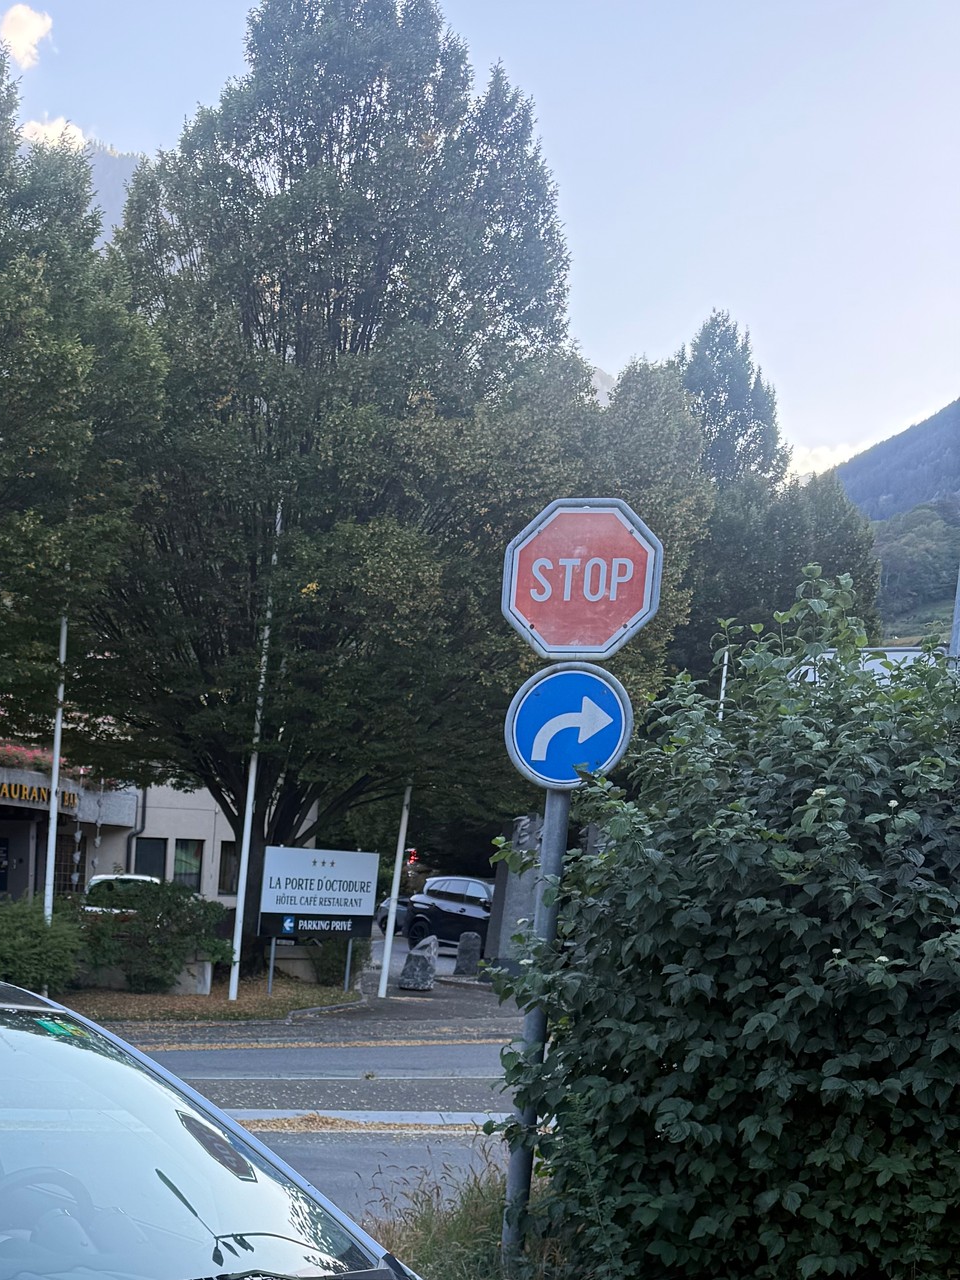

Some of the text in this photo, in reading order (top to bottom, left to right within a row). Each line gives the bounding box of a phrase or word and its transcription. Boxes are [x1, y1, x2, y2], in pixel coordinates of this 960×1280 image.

[529, 556, 634, 602] STOP
[269, 876, 372, 893] LA PORTE D'OCTODURE
[276, 893, 362, 907] HÔTEL CAFÉ RESTAURANT
[298, 919, 352, 931] PARKING PRIVÉ
